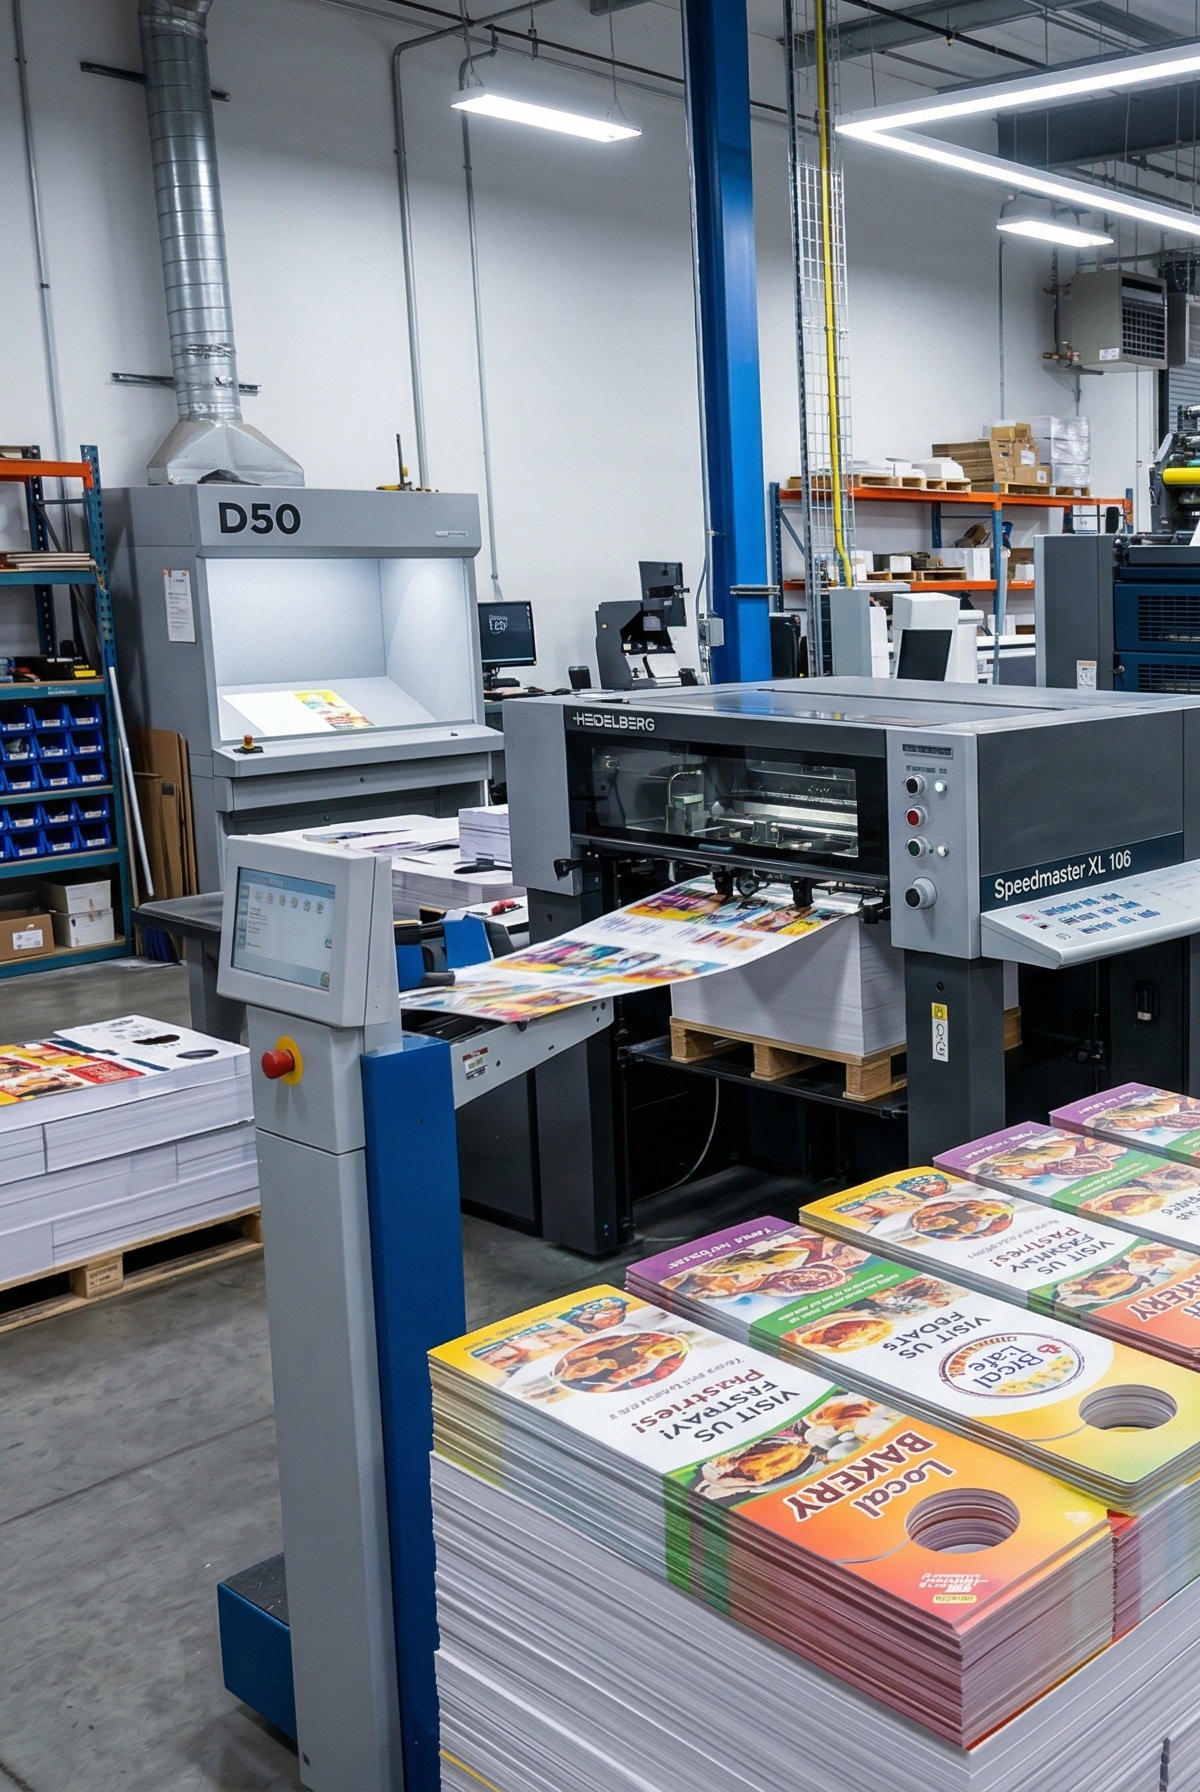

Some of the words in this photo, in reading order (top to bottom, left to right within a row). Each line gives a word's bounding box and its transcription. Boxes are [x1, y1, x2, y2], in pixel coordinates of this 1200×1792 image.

[218, 502, 301, 534] D50
[994, 862, 1086, 901] Speedmaster
[1088, 855, 1106, 877] XL
[1109, 849, 1131, 871] 106
[1074, 1240, 1115, 1263] VISIT
[1037, 1260, 1069, 1276] US
[940, 1316, 992, 1344] VISIT
[898, 1341, 935, 1361] US
[741, 1389, 800, 1423] VISIT
[694, 1418, 734, 1443] US
[784, 1430, 936, 1522] BAKERY
[853, 1457, 954, 1518] Local
